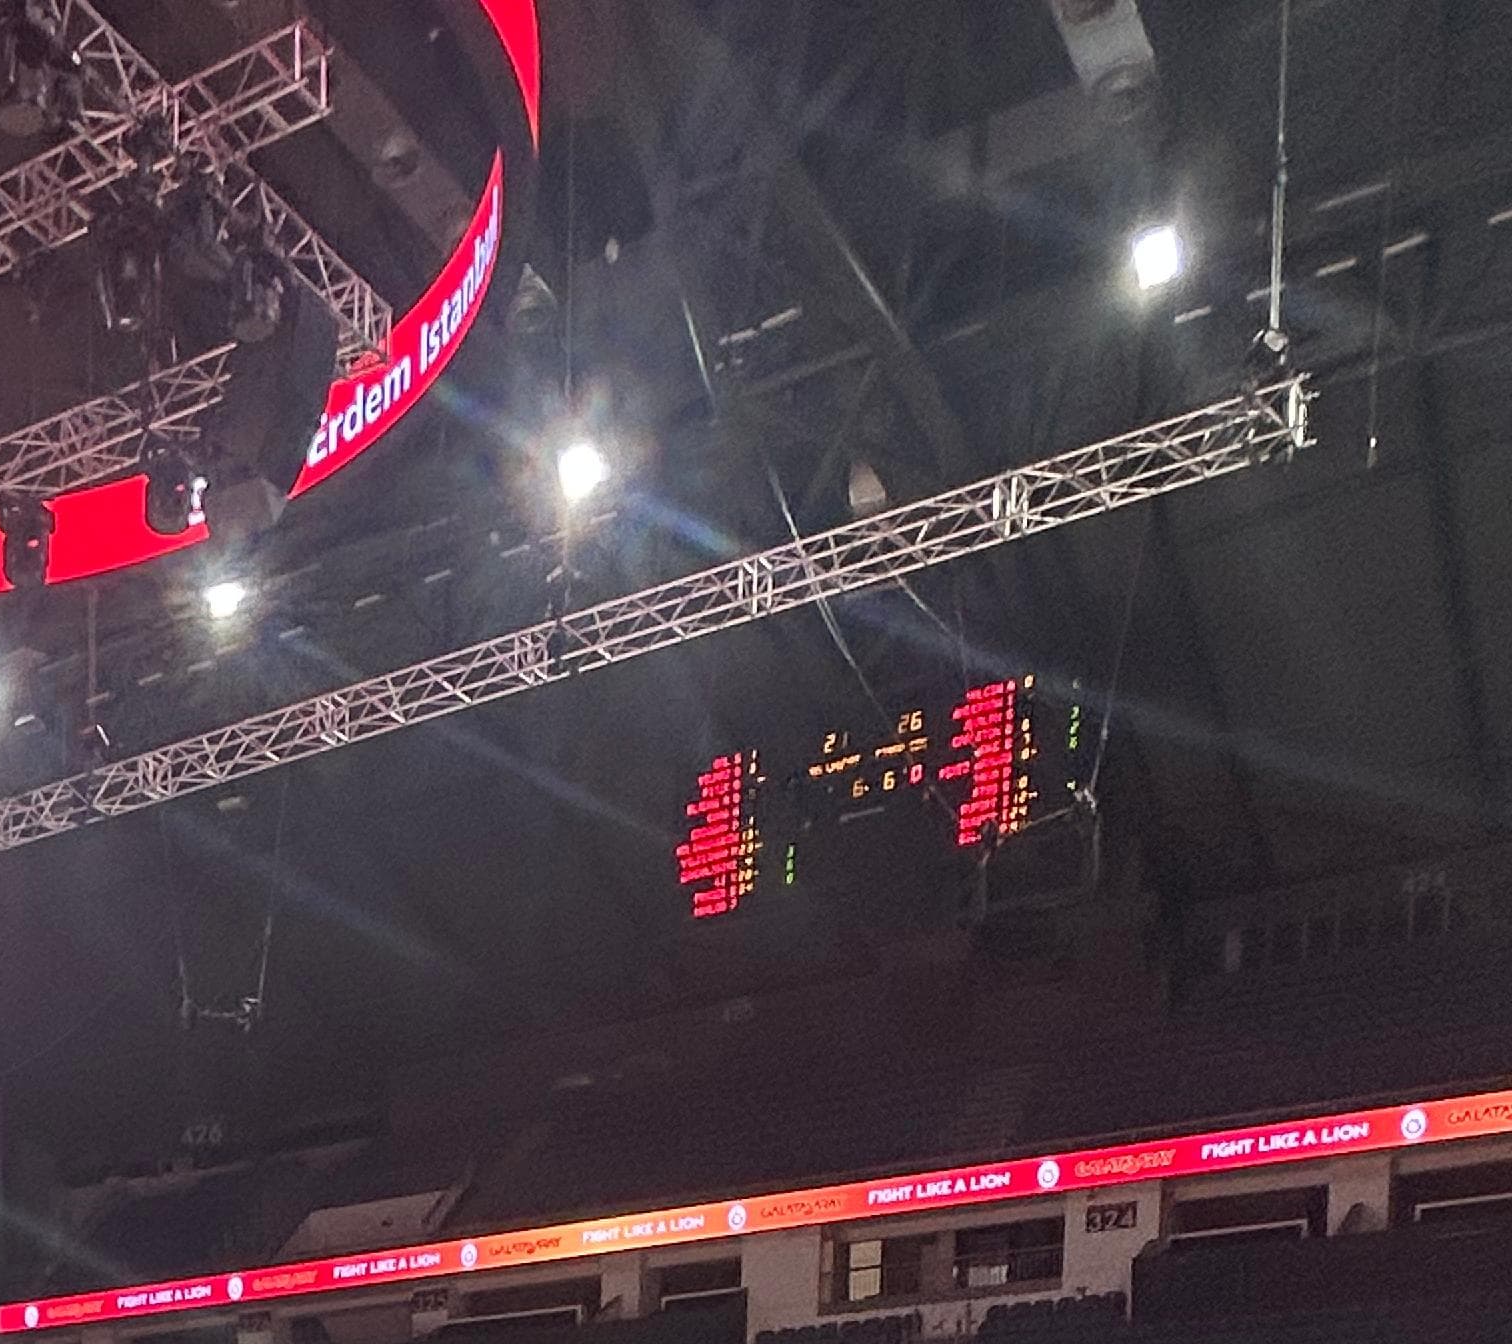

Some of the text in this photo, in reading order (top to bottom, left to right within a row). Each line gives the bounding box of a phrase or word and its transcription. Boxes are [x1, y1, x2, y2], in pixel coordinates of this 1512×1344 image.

[1201, 1121, 1370, 1160] FIGHT LIKE A LION
[868, 1171, 1011, 1206] FIGHT LIKE A LION
[624, 1221, 653, 1239] LIKE
[370, 1259, 398, 1274] LIKE
